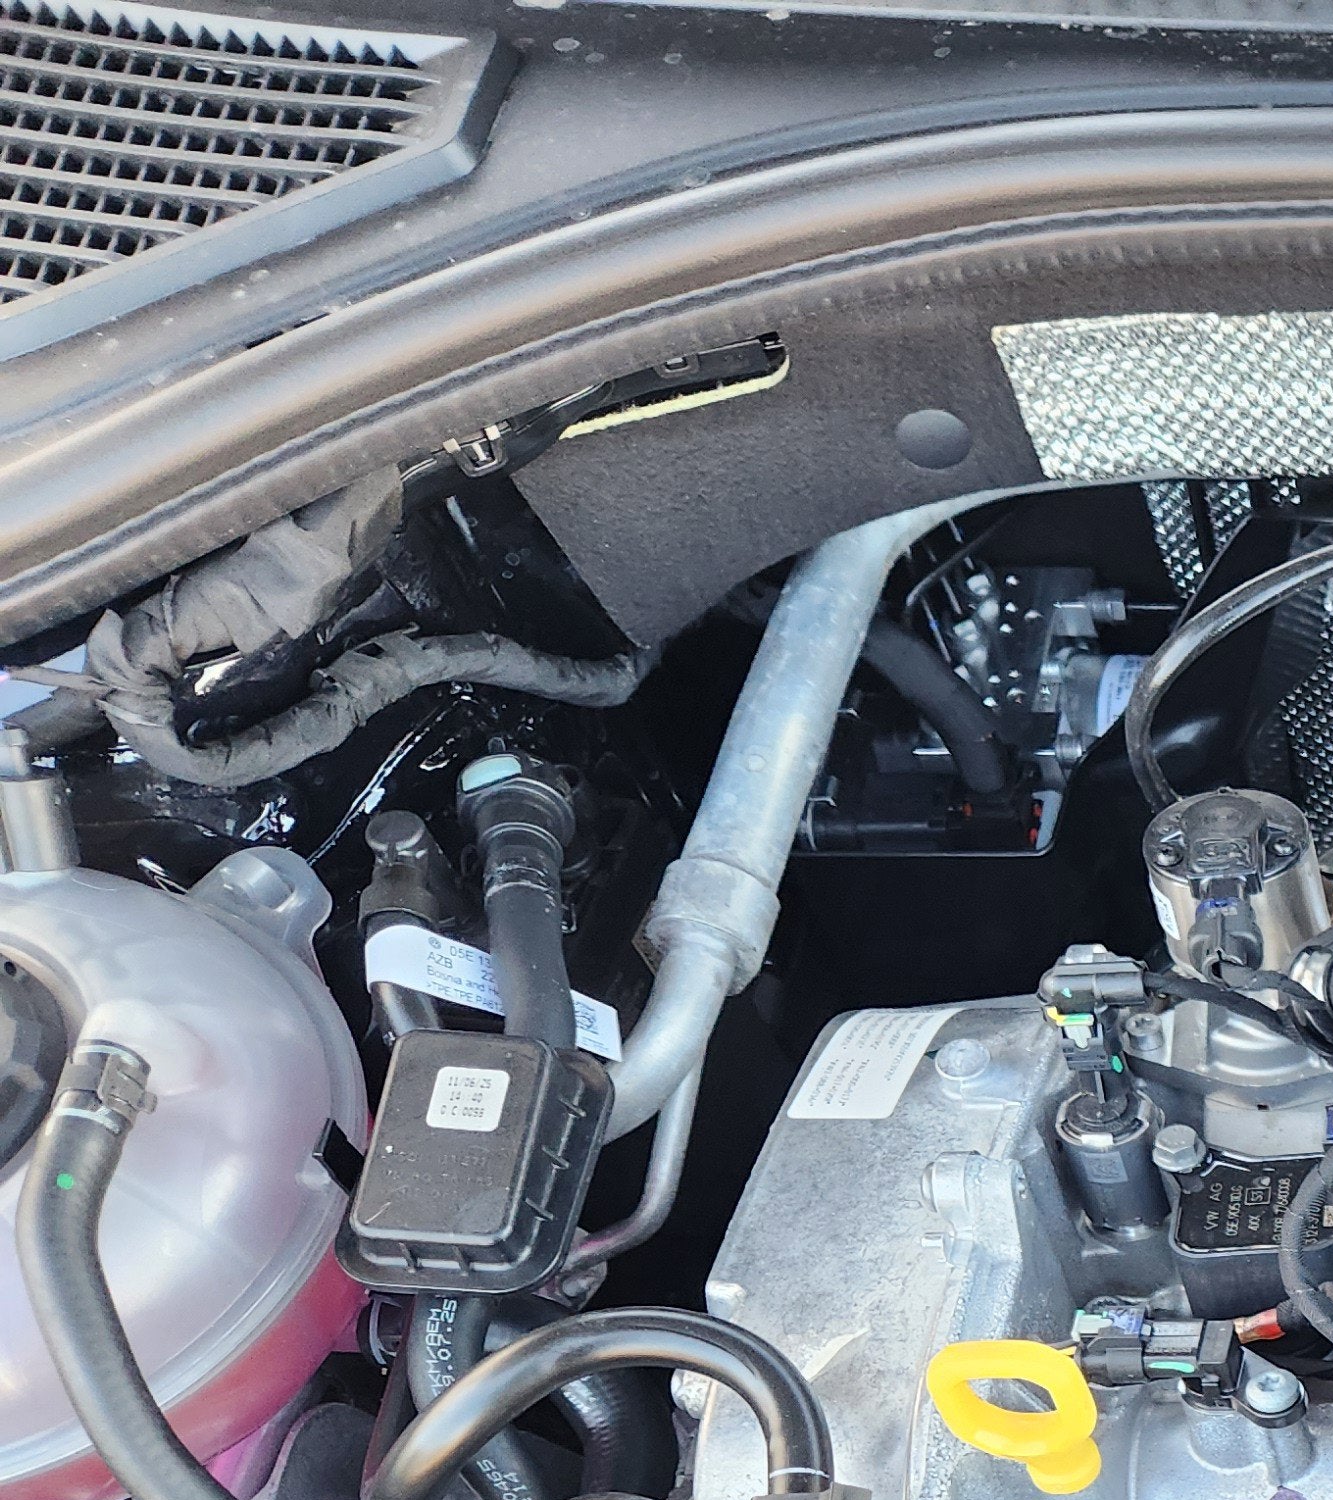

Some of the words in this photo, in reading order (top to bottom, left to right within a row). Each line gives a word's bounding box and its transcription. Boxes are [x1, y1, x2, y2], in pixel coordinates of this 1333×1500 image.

[426, 951, 453, 970] AZB
[449, 945, 475, 964] 05E
[1208, 1182, 1224, 1203] AG
[1202, 1210, 1220, 1232] VW
